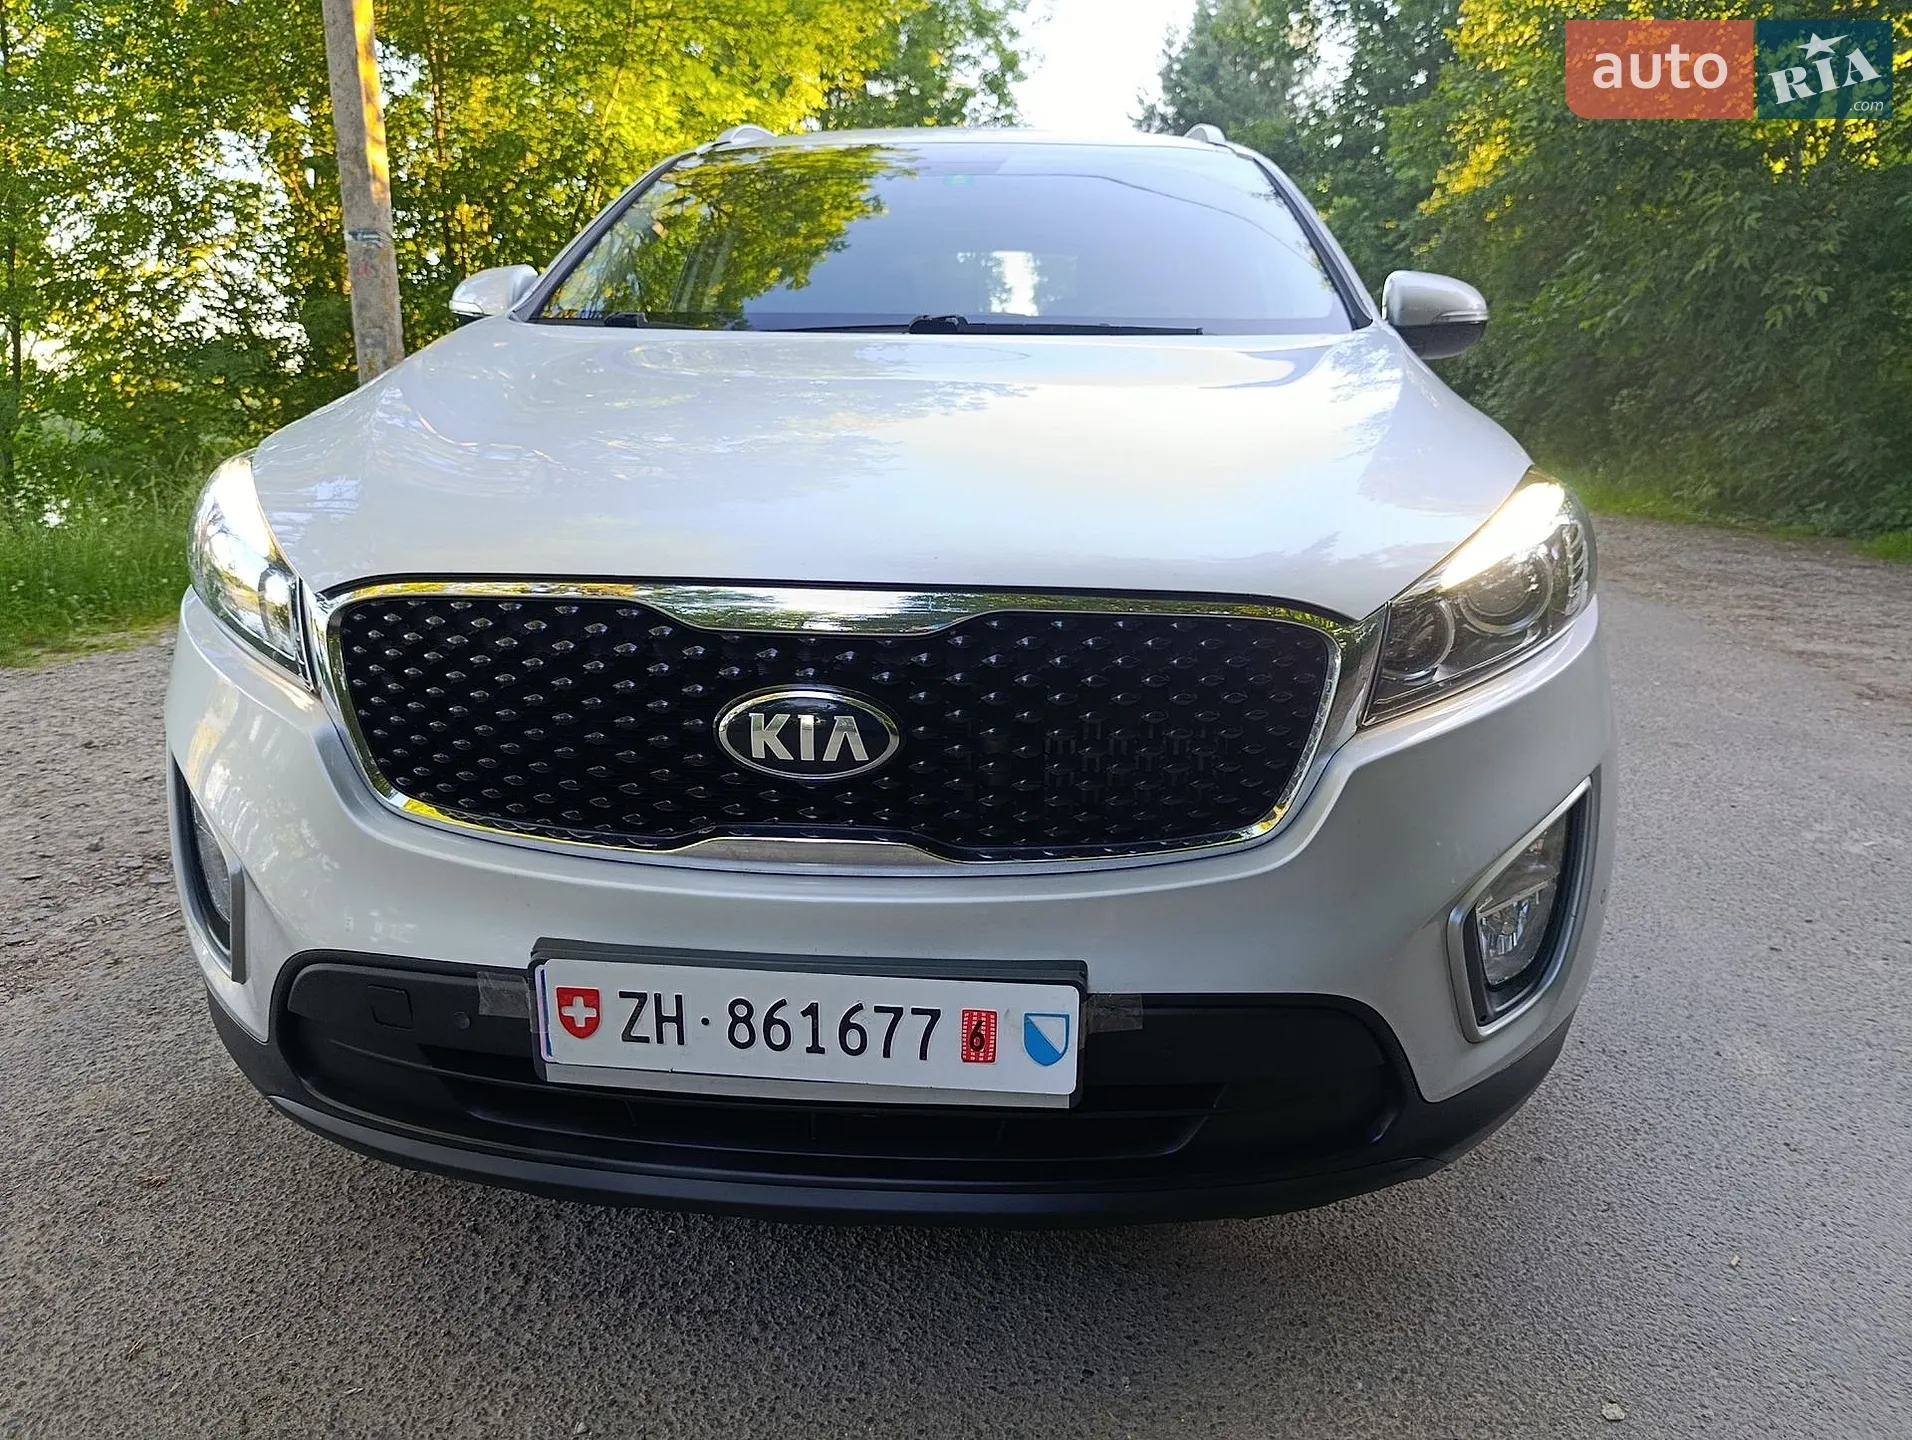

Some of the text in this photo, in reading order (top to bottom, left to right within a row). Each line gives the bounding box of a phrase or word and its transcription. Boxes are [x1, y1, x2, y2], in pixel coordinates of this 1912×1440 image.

[749, 713, 869, 761] KIA
[618, 991, 685, 1045] ZH
[727, 998, 941, 1060] 861677
